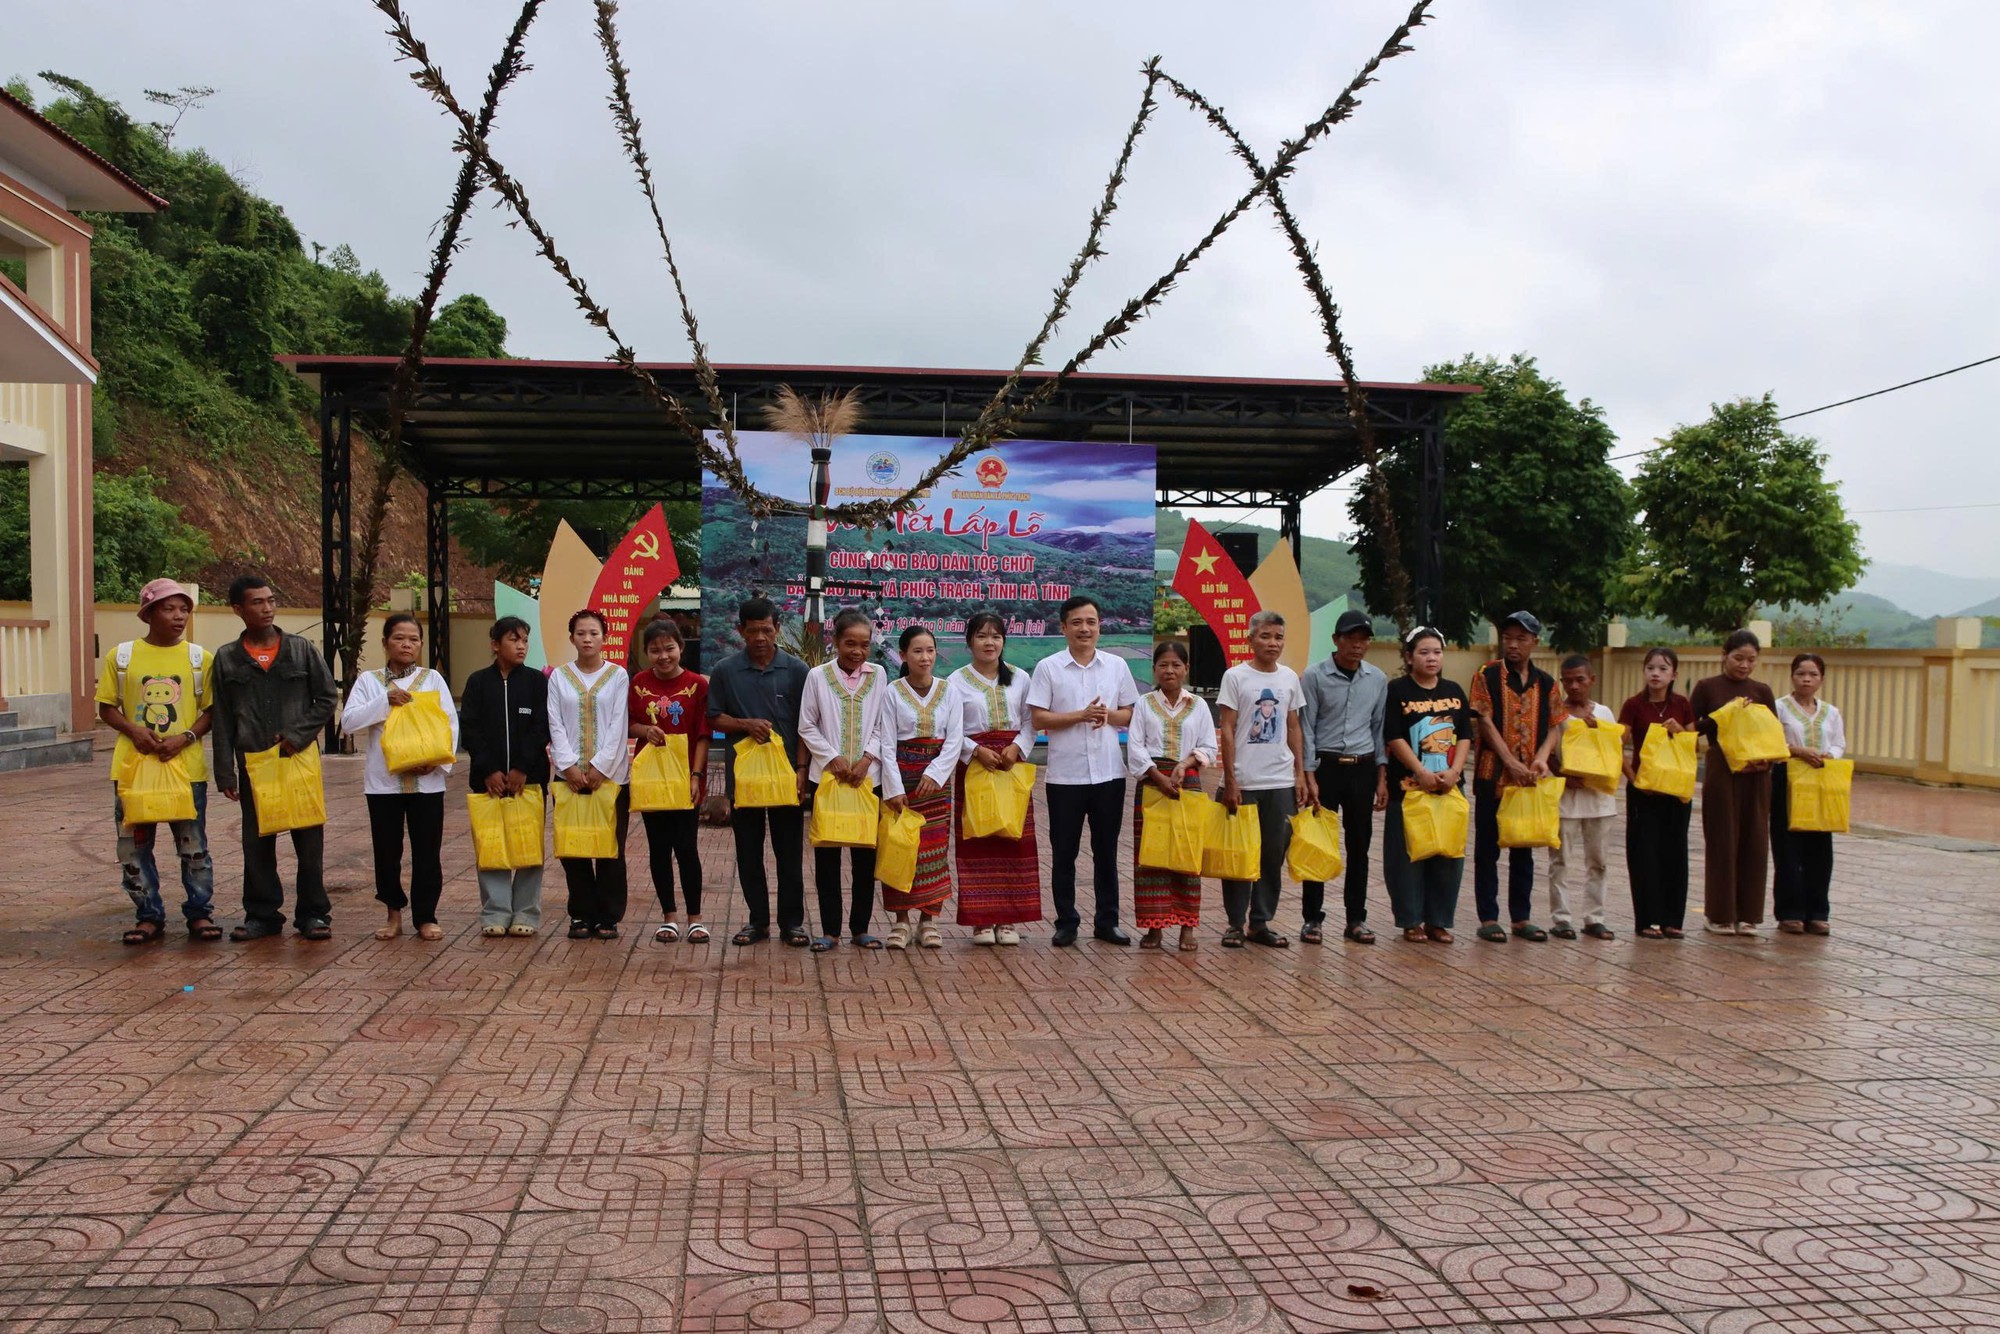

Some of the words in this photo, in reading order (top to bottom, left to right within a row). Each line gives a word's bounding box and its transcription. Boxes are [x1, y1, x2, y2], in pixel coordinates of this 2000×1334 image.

[943, 506, 999, 550] Lấp
[1008, 509, 1045, 537] Lỗ
[829, 549, 866, 569] CÙNG
[911, 550, 938, 571] BÀO
[941, 552, 969, 572] DÂN
[973, 551, 998, 575] TỘC
[1001, 553, 1035, 573] CHỨT
[623, 566, 644, 576] ĐẢNG
[623, 579, 632, 590] VÀ
[880, 577, 898, 597] XÃ
[901, 578, 936, 598] PHÚC
[939, 582, 985, 602] TRẠCH,
[987, 578, 1017, 600] TỈNH
[1020, 580, 1039, 600] HÀ
[1041, 581, 1071, 601] TĨNH
[602, 592, 618, 603] NHÀ
[1214, 597, 1230, 609] PHÁT
[1231, 598, 1244, 609] HUY
[612, 621, 628, 631] TÂM
[937, 617, 943, 631] 8
[945, 619, 965, 632] năm
